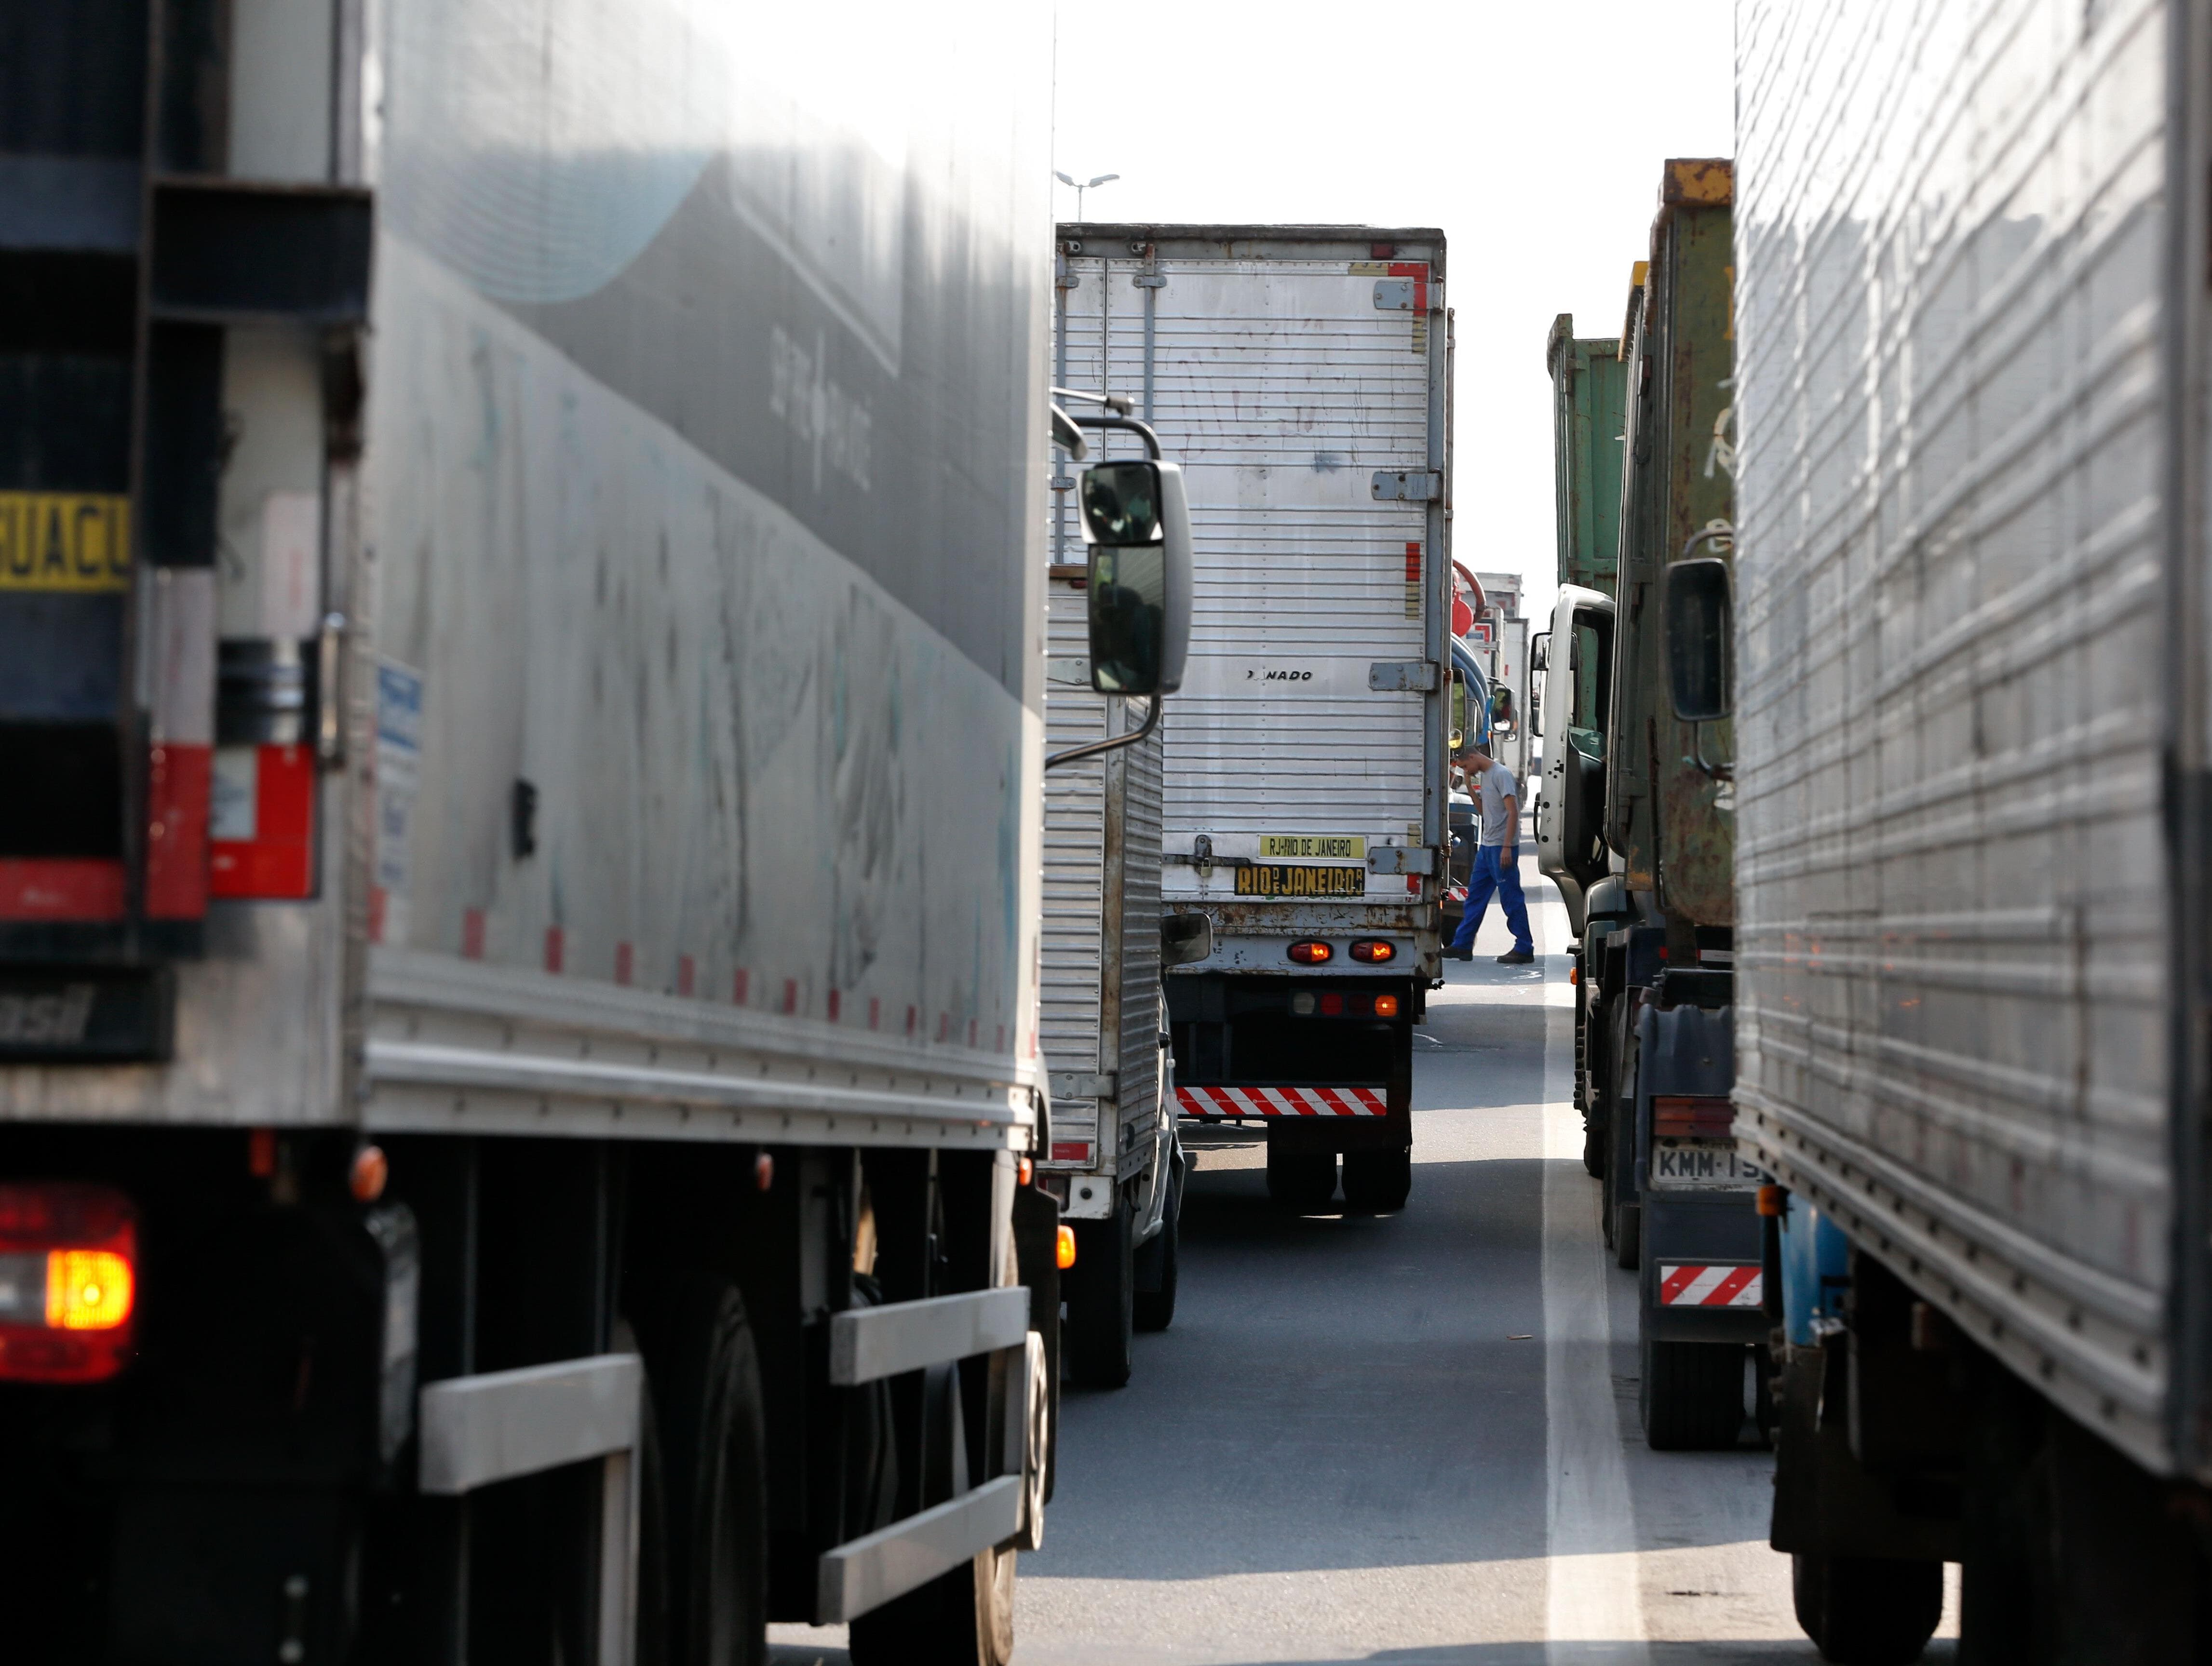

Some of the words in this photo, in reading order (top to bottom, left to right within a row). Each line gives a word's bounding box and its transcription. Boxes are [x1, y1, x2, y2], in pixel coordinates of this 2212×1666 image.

[1301, 839, 1312, 856] DE
[1315, 839, 1351, 857] JANEIRO
[1238, 866, 1270, 894] RIO
[1281, 868, 1354, 895] JANEIRO
